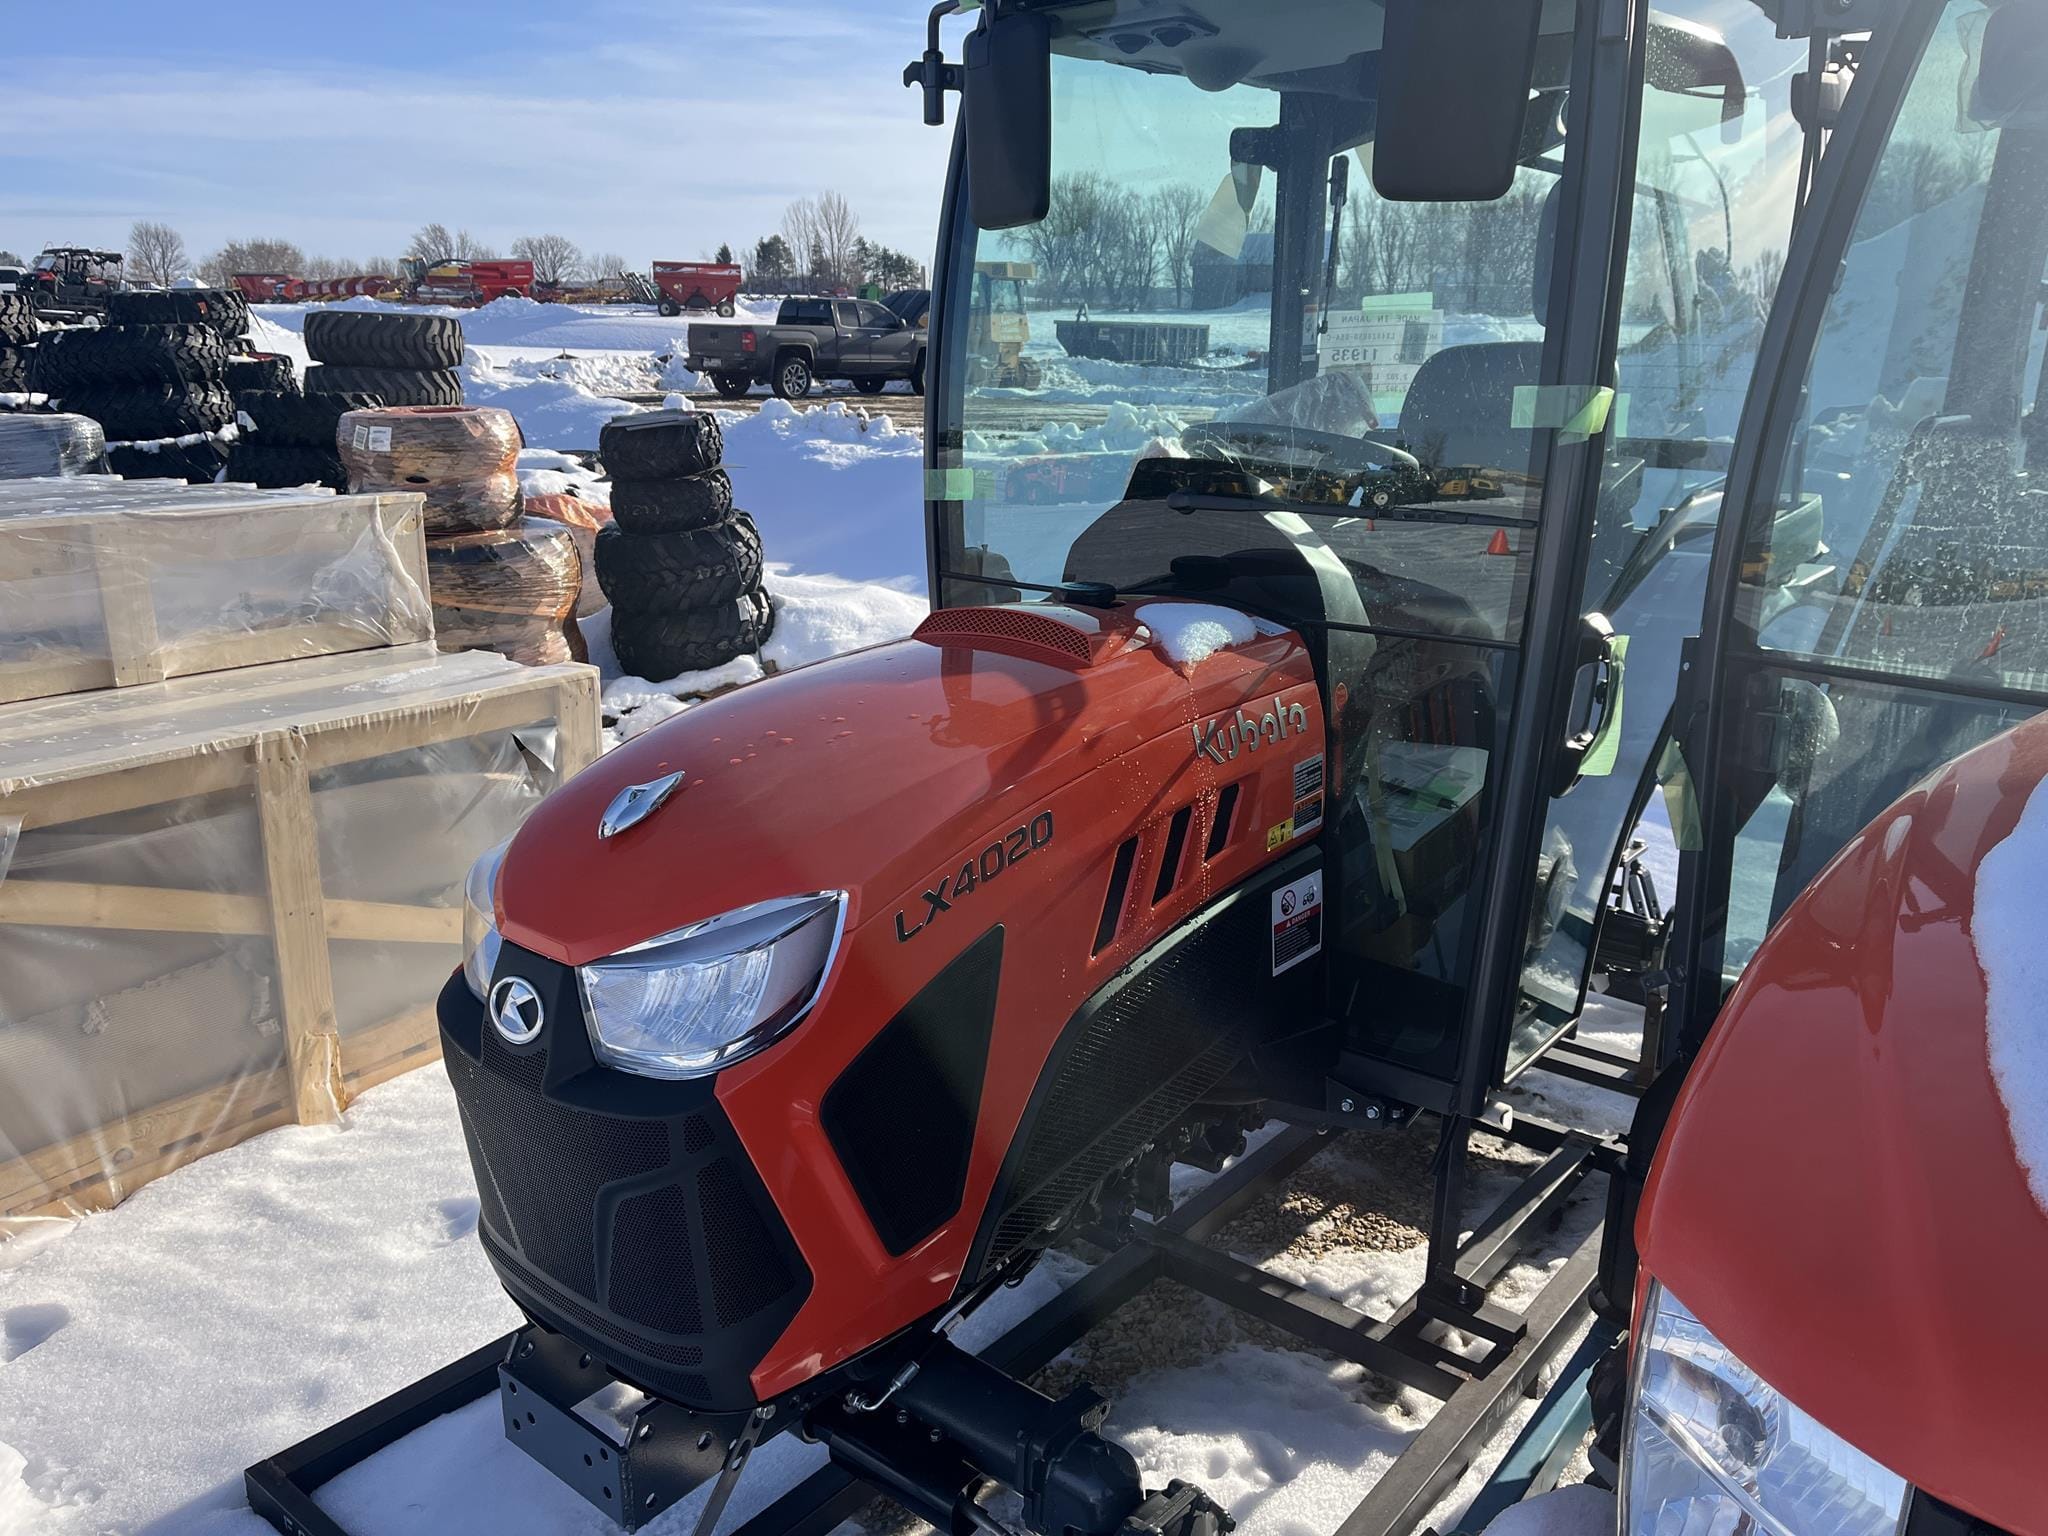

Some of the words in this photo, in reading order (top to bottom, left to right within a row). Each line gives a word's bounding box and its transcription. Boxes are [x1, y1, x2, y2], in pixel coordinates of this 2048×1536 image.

[1192, 696, 1308, 764] Kubota
[894, 809, 1054, 943] LX4020
[1485, 1372, 1525, 1433] FORK
